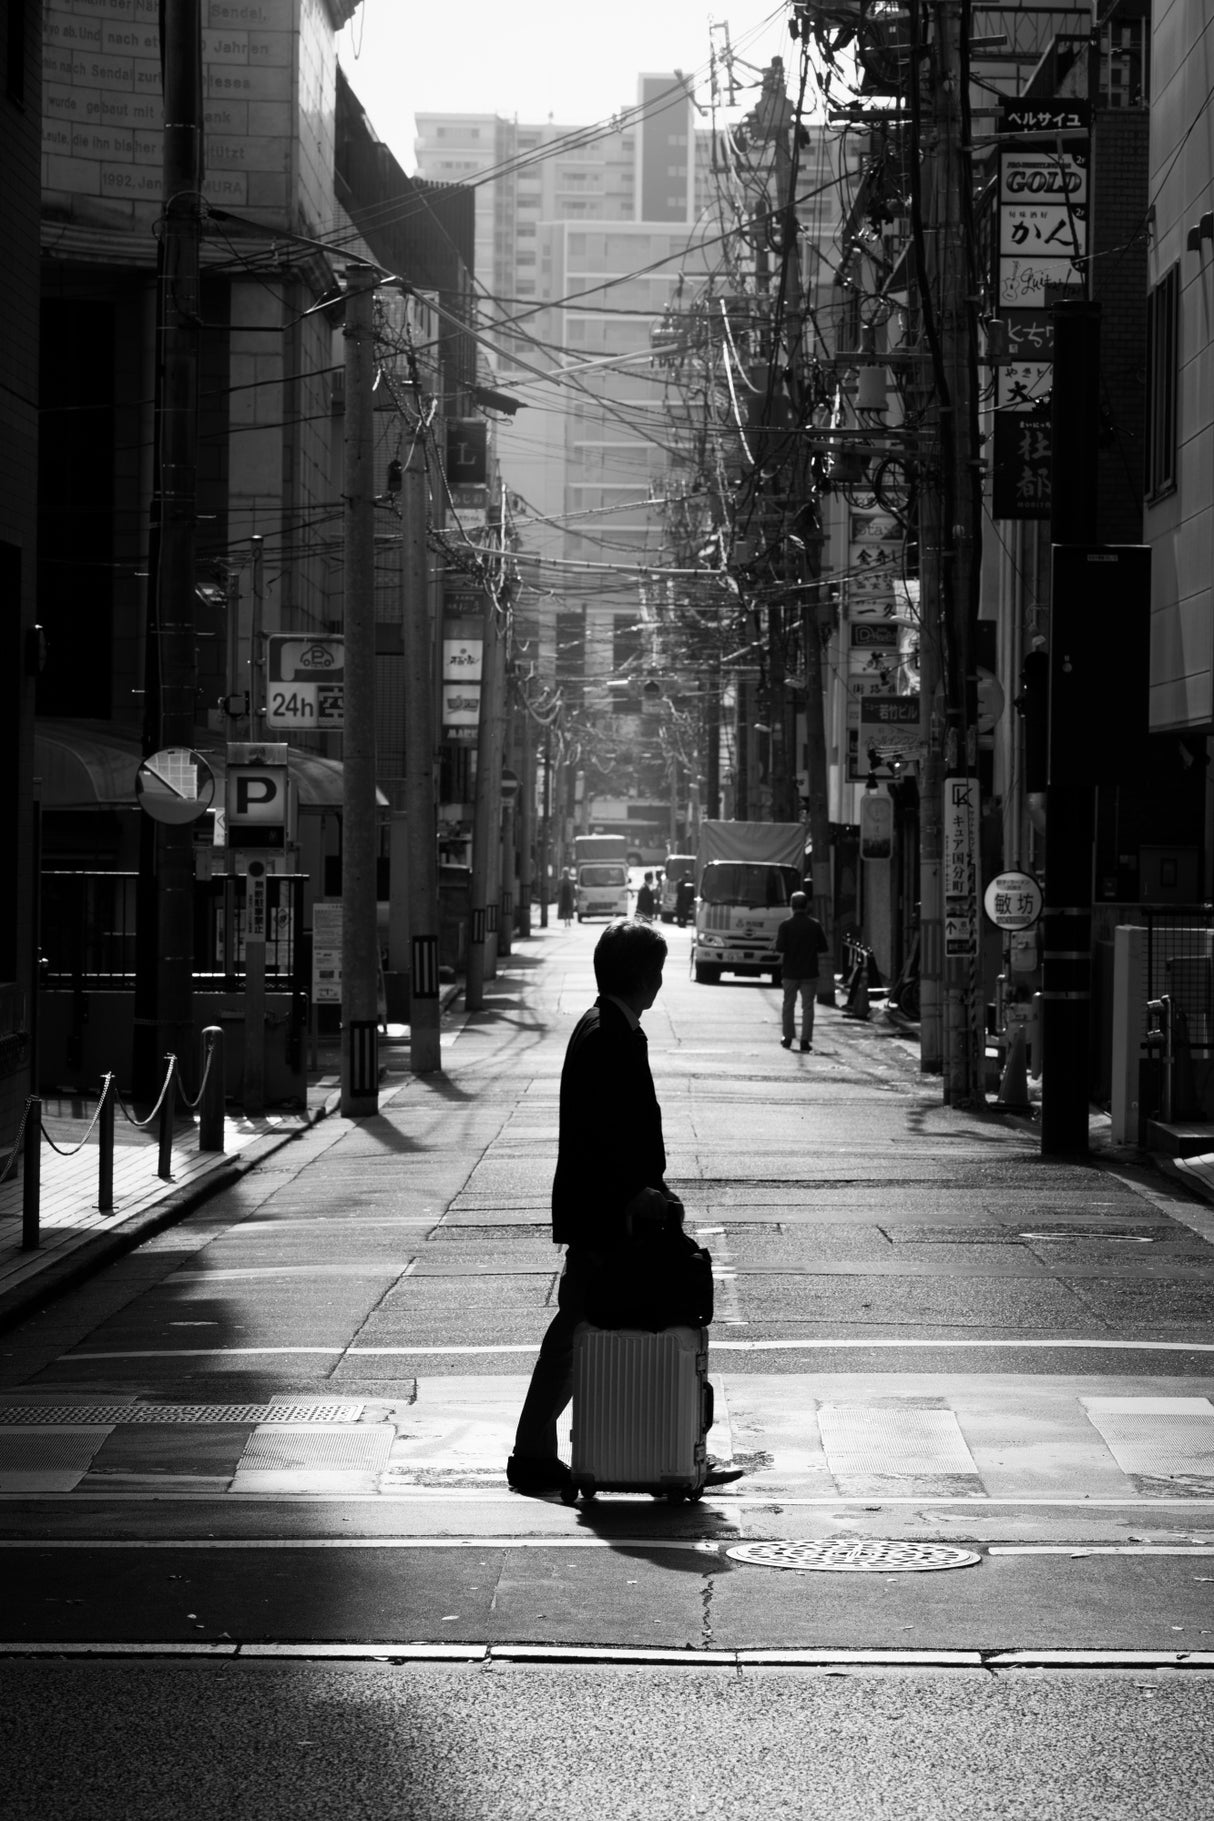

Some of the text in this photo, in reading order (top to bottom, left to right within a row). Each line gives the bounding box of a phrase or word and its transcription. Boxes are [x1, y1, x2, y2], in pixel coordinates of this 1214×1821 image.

[79, 27, 101, 42] Und
[108, 33, 138, 46] nach
[144, 35, 159, 47] et
[214, 40, 268, 55] Jahren
[60, 62, 86, 76] nach
[48, 97, 155, 119] wurde gebaut mit
[1008, 112, 1081, 128] ベルサイユ
[73, 135, 89, 147] die
[93, 136, 110, 149] ihn
[114, 139, 157, 153] bisher
[103, 174, 136, 190] 1992,
[1007, 171, 1082, 193] GOLD
[1011, 219, 1075, 247] かん
[457, 442, 476, 465] L
[273, 693, 313, 717] 24h
[237, 777, 277, 814] P
[953, 815, 965, 893] キュア国分町
[995, 893, 1034, 914] 敏坊
